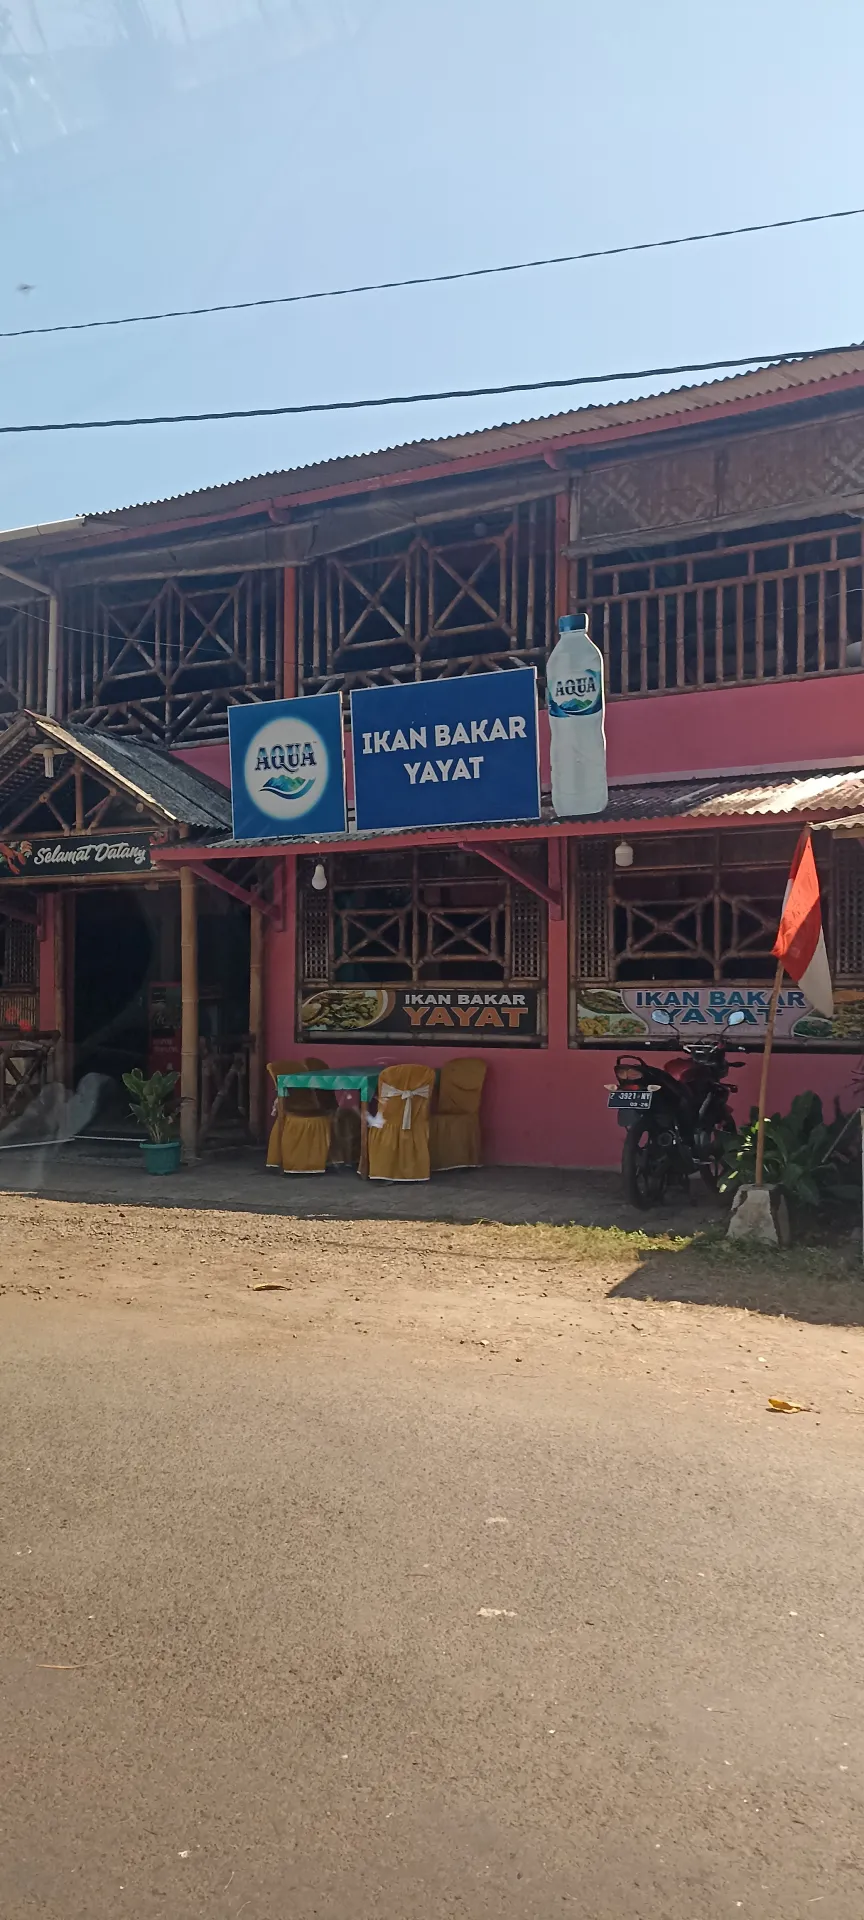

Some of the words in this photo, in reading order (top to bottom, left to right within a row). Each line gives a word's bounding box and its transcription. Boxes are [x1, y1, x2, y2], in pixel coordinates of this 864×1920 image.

[555, 677, 597, 697] AQUA
[362, 726, 427, 754] IKAN
[434, 715, 527, 746] BAKAR
[254, 742, 317, 773] AQUA
[403, 756, 484, 785] YAYAT
[34, 844, 94, 865] Selamat
[94, 841, 147, 865] Datang
[405, 994, 451, 1005] IKAN
[457, 994, 526, 1005] BAKAR
[636, 991, 699, 1007] IKAN
[402, 1006, 529, 1028] YAYAT
